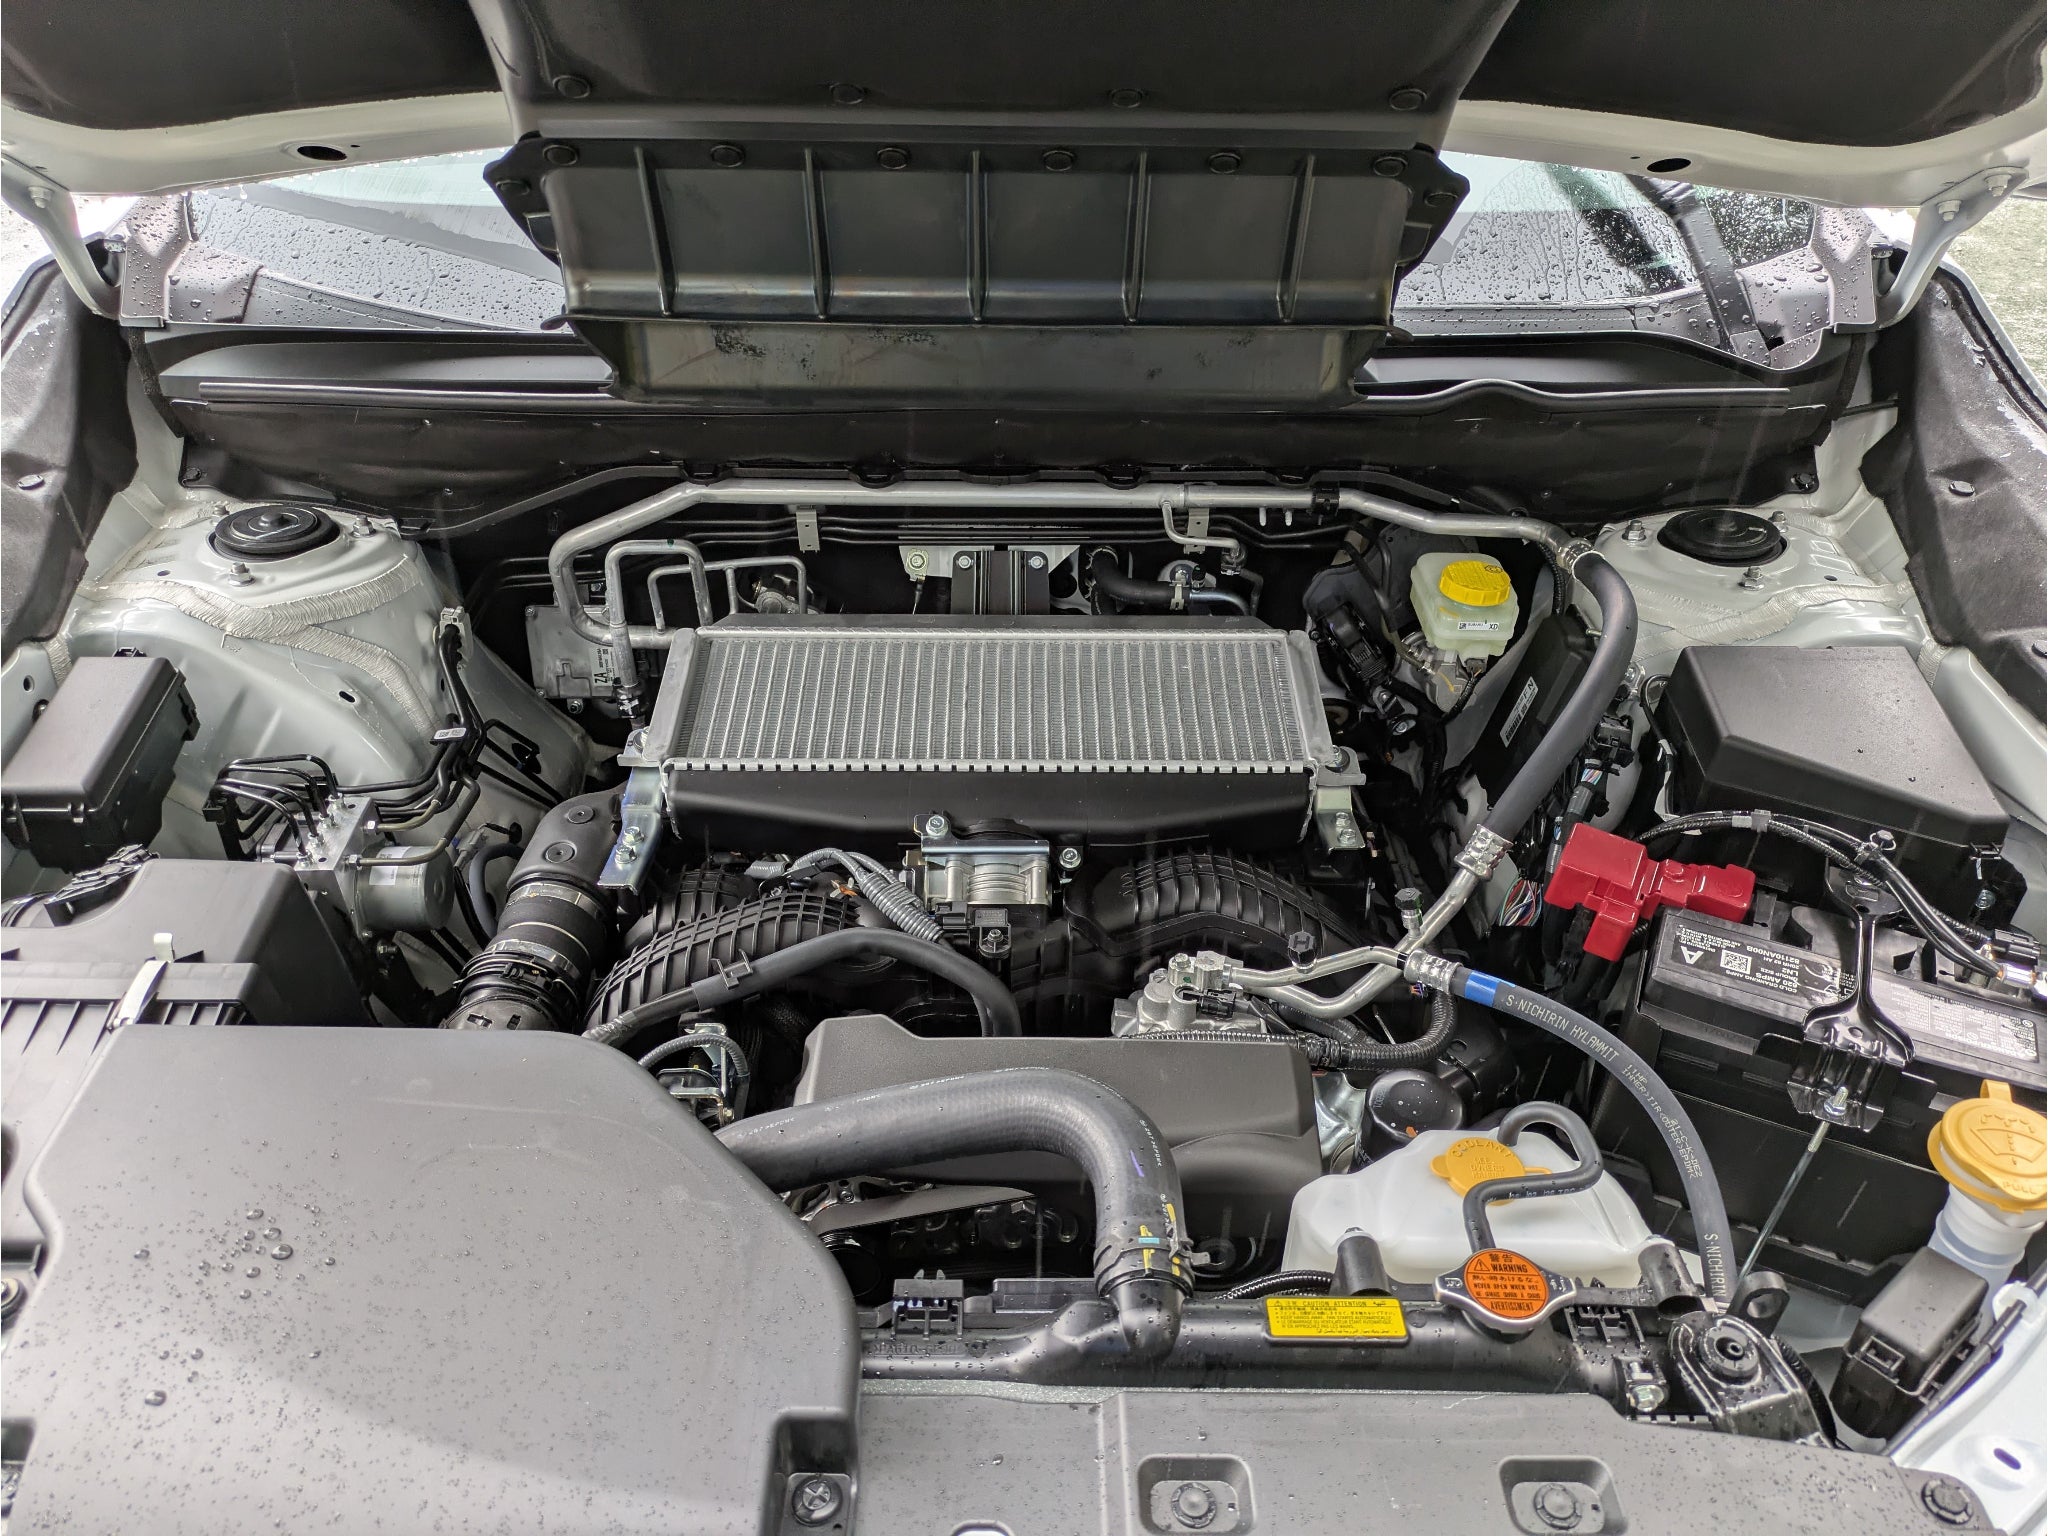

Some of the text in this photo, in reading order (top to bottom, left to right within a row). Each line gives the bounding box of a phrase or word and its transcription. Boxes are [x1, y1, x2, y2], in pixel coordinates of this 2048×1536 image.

[594, 672, 607, 683] ZA
[1293, 936, 1310, 949] H
[1756, 972, 1780, 984] AMPS
[1782, 968, 1798, 976] LN2
[1726, 970, 1798, 992] COLD CRANKING AMPS
[1570, 1024, 1620, 1062] HYLAMMIT
[1452, 1140, 1512, 1158] COOLANT
[2002, 1182, 2038, 1194] PULL
[1492, 1263, 1528, 1272] WARNING
